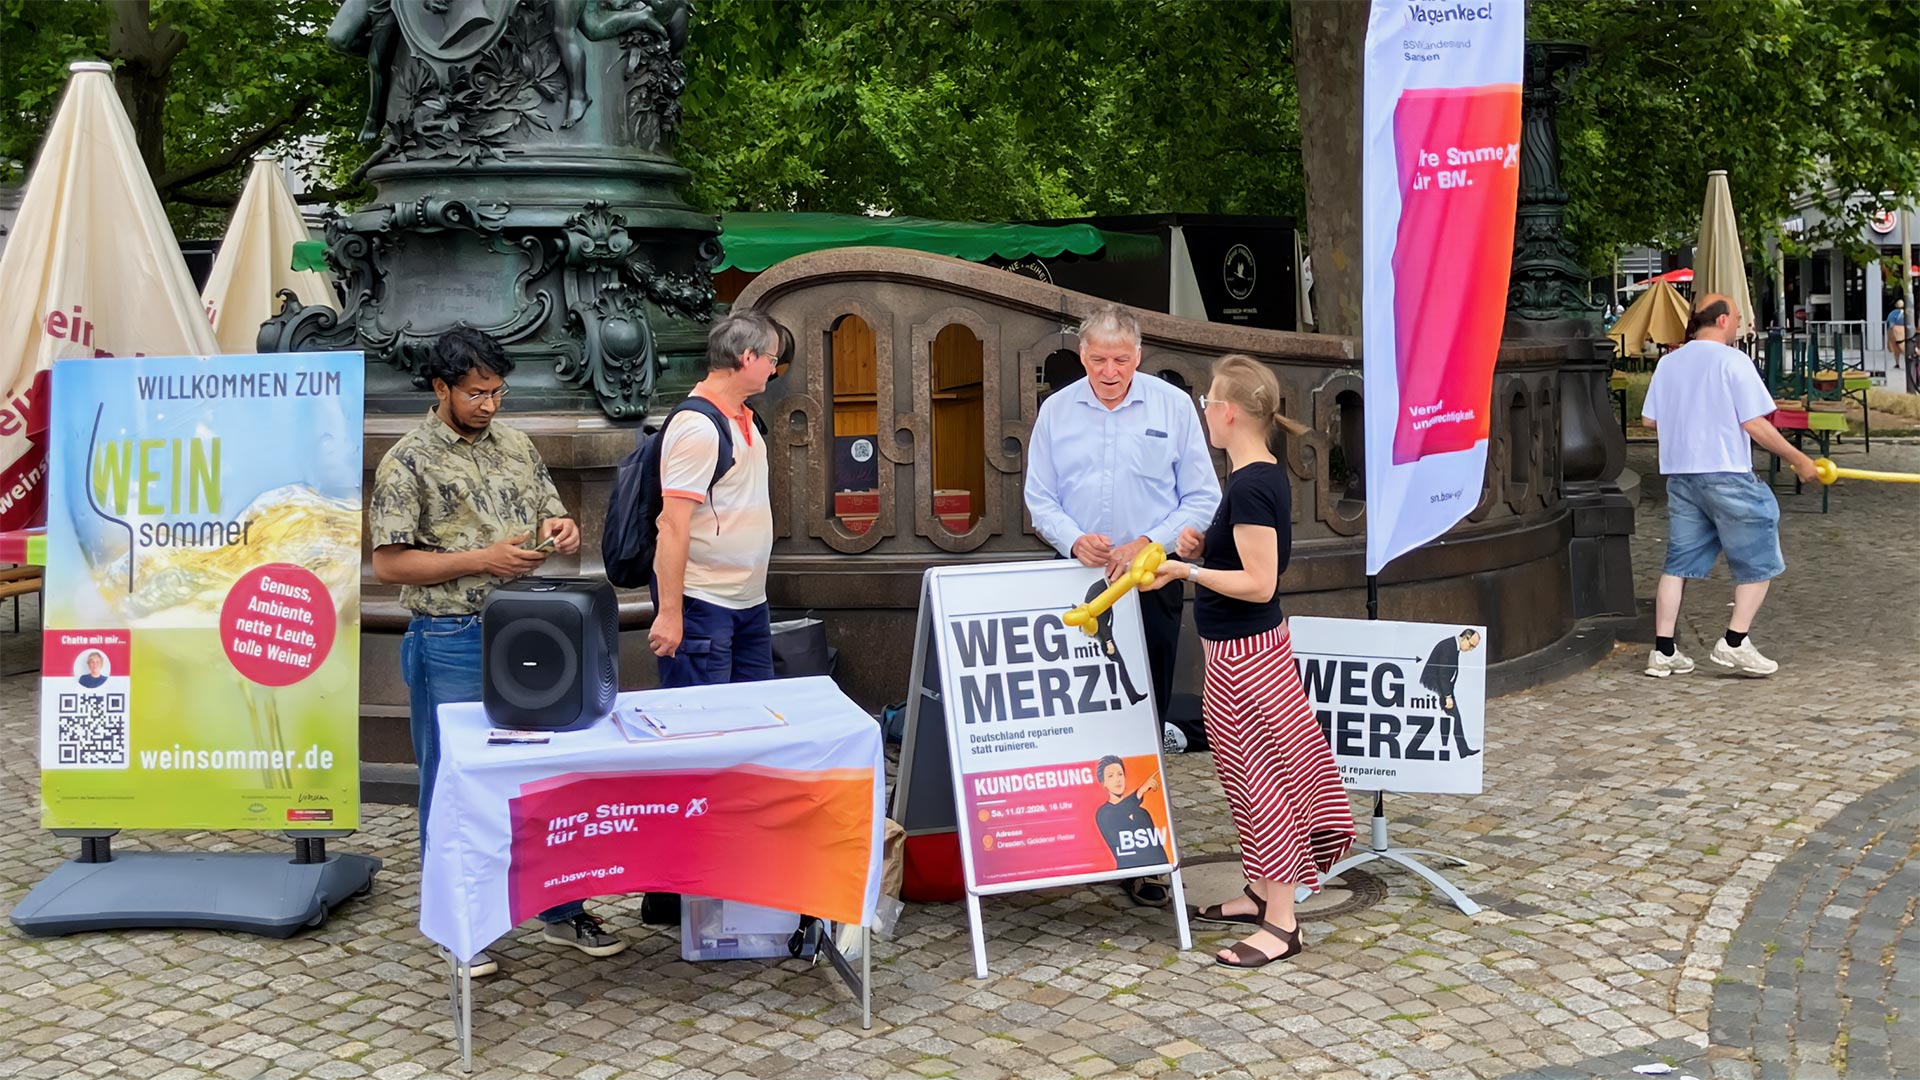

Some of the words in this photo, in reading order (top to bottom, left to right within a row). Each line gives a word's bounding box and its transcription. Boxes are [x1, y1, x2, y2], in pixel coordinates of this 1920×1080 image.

[138, 373, 288, 401] WILLKOMMEN
[295, 371, 341, 396] ZUM
[93, 438, 221, 515] WEIN
[139, 520, 253, 547] sommer
[260, 576, 312, 603] Genuss,
[248, 595, 314, 626] Ambiente,
[236, 618, 272, 637] nette
[275, 623, 316, 649] Leute,
[950, 614, 1069, 668] WEG
[1074, 642, 1100, 659] mit
[233, 637, 262, 657] tolle
[267, 643, 312, 668] Weine!
[960, 663, 1122, 724] MERZ!
[1294, 658, 1405, 708] WEG
[1410, 695, 1438, 710] mit
[970, 730, 1025, 744] Deutschland
[1028, 726, 1074, 739] reparieren
[971, 745, 992, 755] statt
[995, 741, 1039, 752] ruinieren.
[140, 744, 334, 769] weinsommer.de
[1349, 766, 1397, 776] reparieren
[974, 767, 1094, 796] KUNDGEBUNG
[548, 812, 589, 831] Ihre
[596, 802, 679, 818] Stimme
[546, 830, 577, 846] für
[583, 818, 638, 837] BSW.
[1119, 826, 1167, 850] BSW
[543, 865, 625, 888] sn.bsw-vg.de
